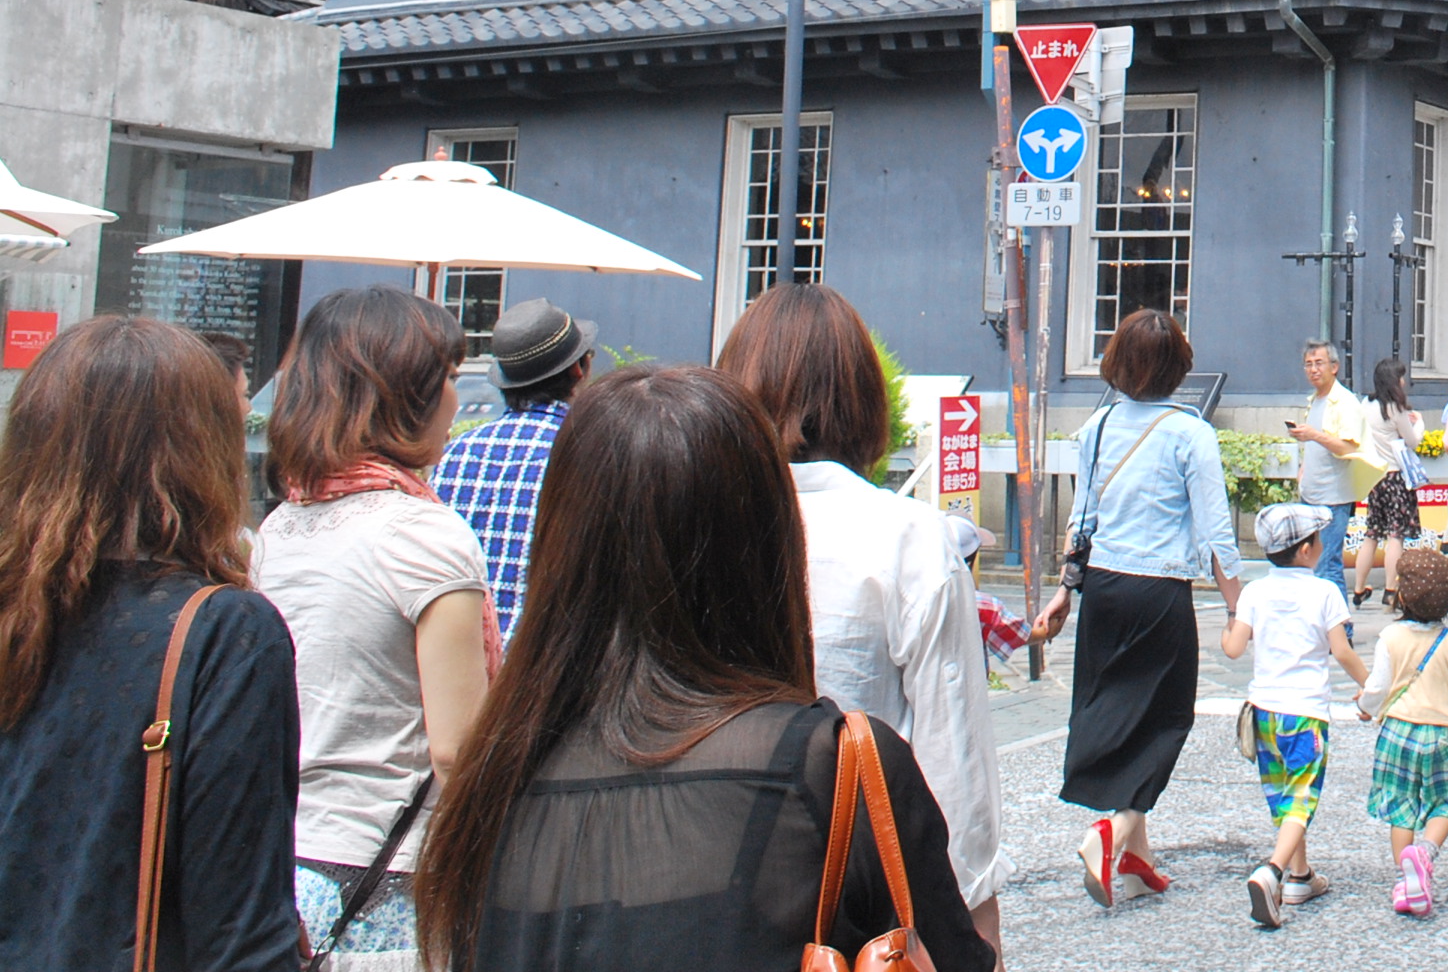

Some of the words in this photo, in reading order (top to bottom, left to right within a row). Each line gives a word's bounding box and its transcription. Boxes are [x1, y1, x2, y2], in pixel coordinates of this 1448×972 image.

[1030, 39, 1079, 58] 止まれ
[1014, 187, 1073, 203] 自動車
[1024, 205, 1062, 221] 7-19
[942, 434, 978, 451] ながはま
[944, 451, 977, 471] 会場
[943, 473, 977, 491] 徒歩5分
